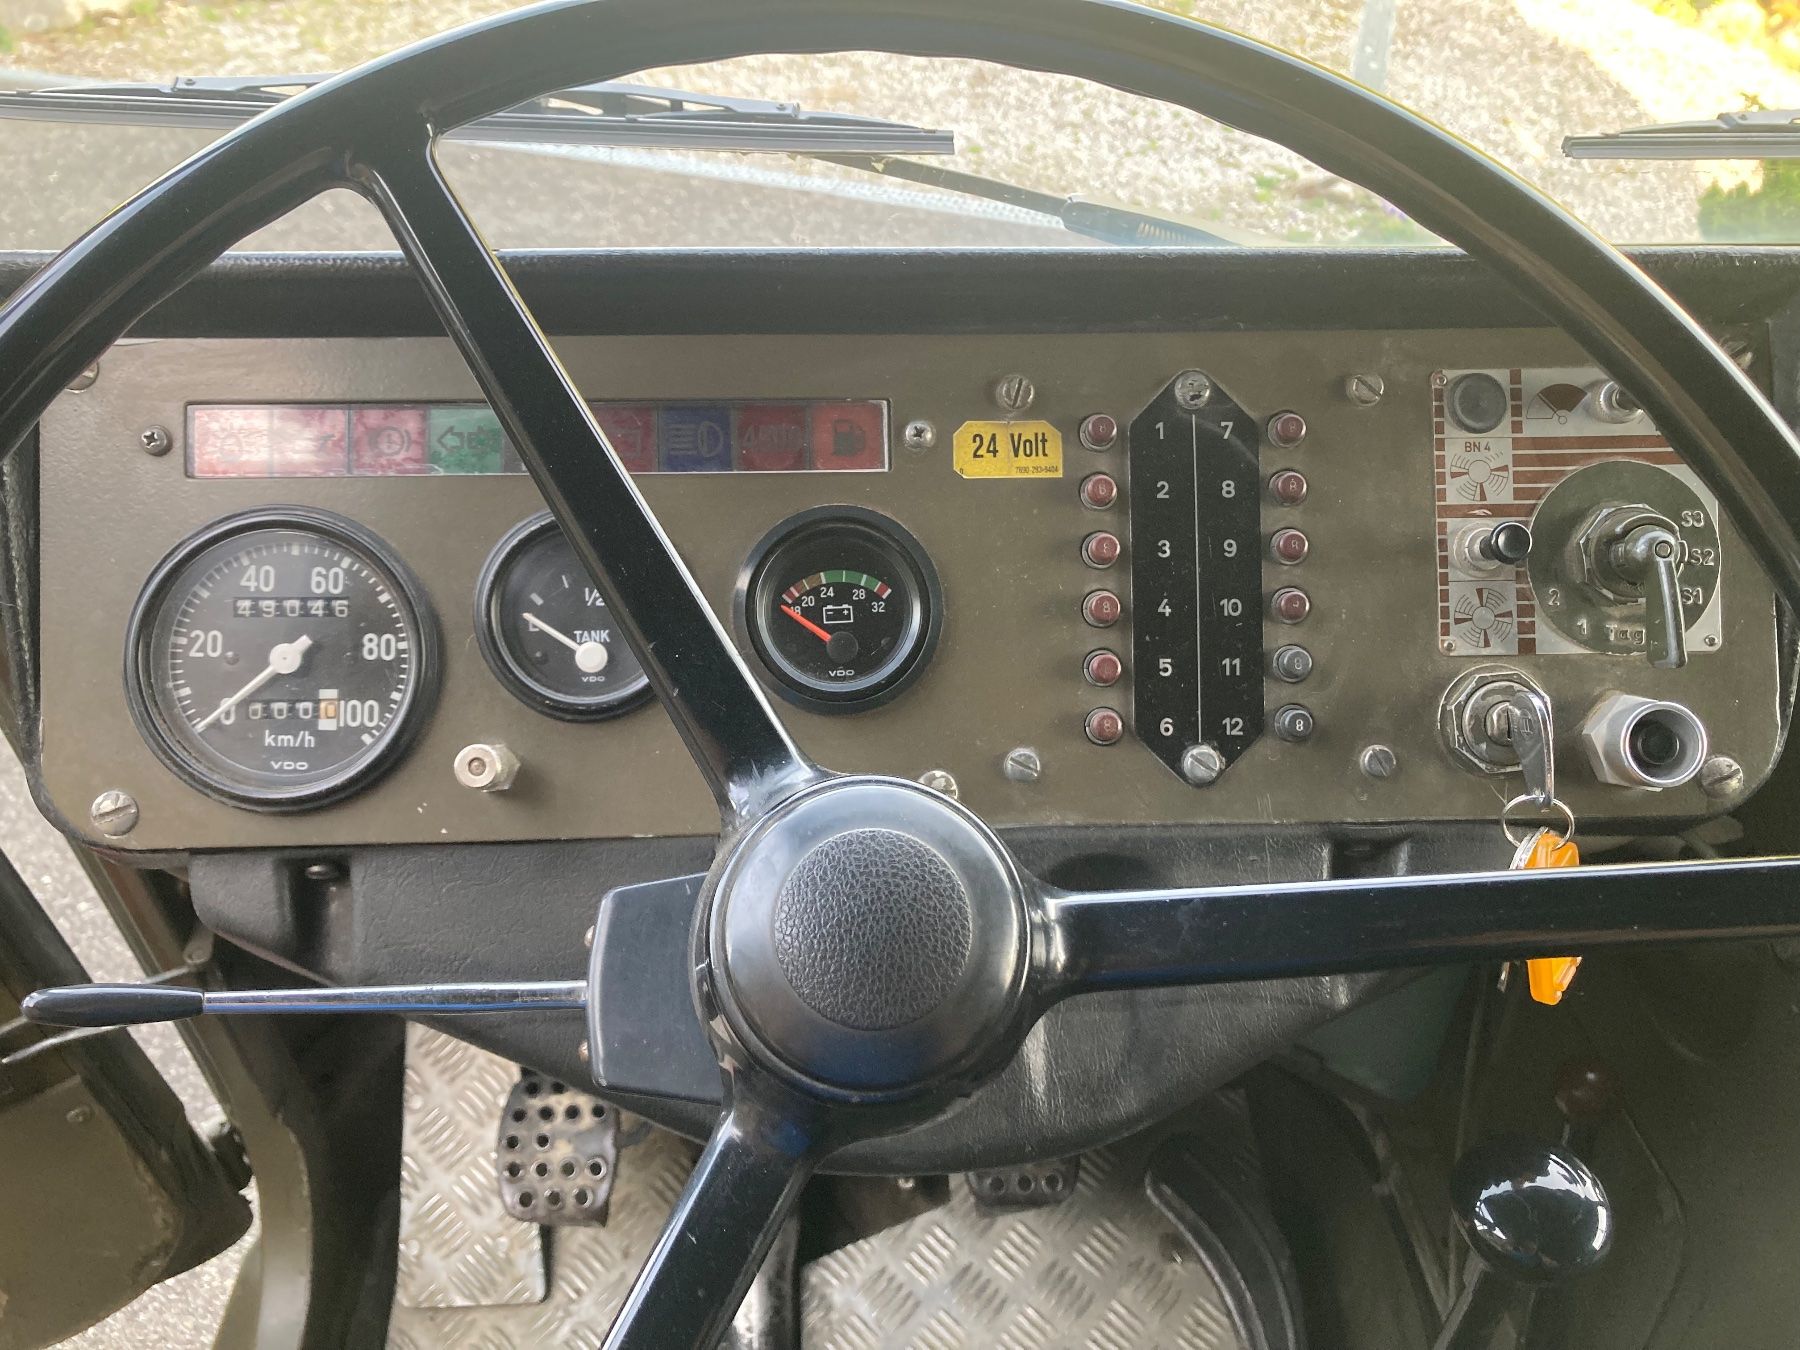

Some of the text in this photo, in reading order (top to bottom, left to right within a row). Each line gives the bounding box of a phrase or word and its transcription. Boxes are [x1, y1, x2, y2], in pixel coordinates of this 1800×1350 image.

[1156, 422, 1163, 439] 1
[1221, 422, 1233, 439] 7
[973, 432, 1048, 458] 24 Volt
[1465, 442, 1491, 452] BN 4
[1157, 481, 1169, 498] 2
[1222, 480, 1235, 498] 8
[1681, 510, 1704, 527] S3
[1158, 540, 1170, 557] 3
[1224, 539, 1237, 557] 9
[1691, 548, 1714, 566] S2
[240, 565, 275, 592] 40
[311, 566, 344, 594] 60
[820, 587, 834, 598] 24
[852, 589, 866, 600] 28
[1548, 588, 1560, 606] 2
[1682, 587, 1703, 605] S1
[801, 596, 815, 607] 20
[871, 602, 886, 613] 32
[1158, 599, 1171, 616] 4
[1220, 599, 1242, 616] 10
[1576, 618, 1587, 635] 1
[1605, 624, 1646, 645] Tag
[189, 630, 223, 657] 20
[573, 630, 610, 643] TANK
[362, 633, 396, 660] 80
[828, 669, 855, 677] VDO
[1160, 659, 1172, 676] 5
[1222, 658, 1240, 675] 11
[220, 698, 235, 725] 0
[339, 700, 379, 728] 100
[1160, 718, 1173, 736] 6
[1223, 718, 1243, 735] 12
[264, 729, 316, 748] km/h
[270, 761, 308, 770] VDO
